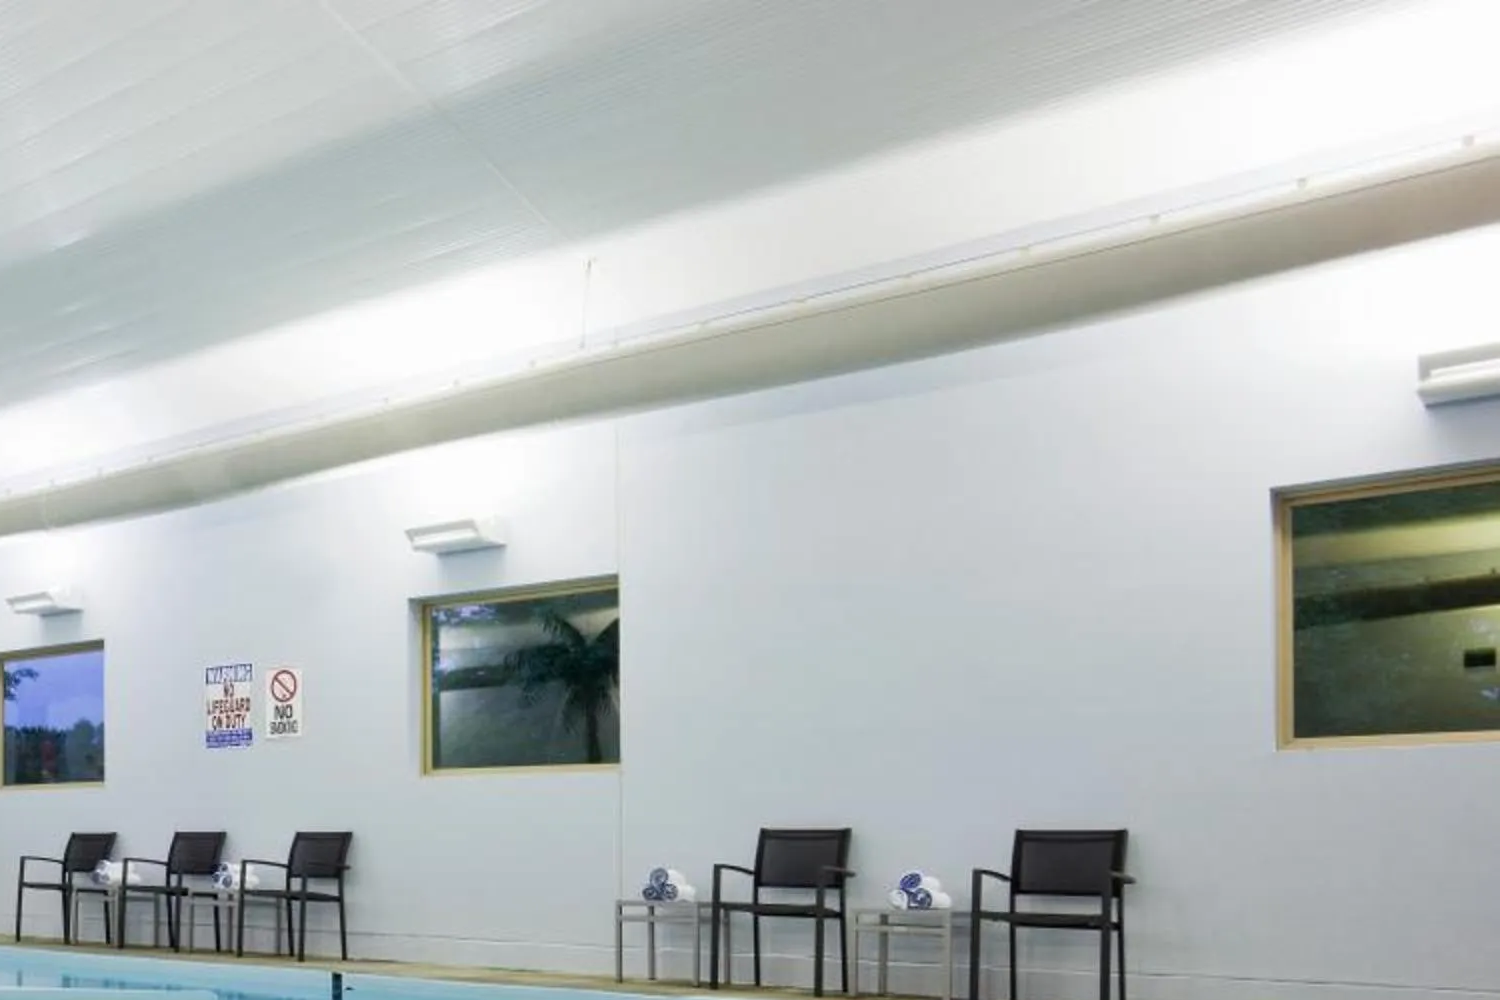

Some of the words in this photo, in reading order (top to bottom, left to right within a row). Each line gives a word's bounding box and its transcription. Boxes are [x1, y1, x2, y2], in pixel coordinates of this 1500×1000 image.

[207, 697, 250, 714] LIFEGUARD
[273, 704, 293, 719] NO
[212, 715, 223, 731] ON
[225, 713, 246, 729] DUTY
